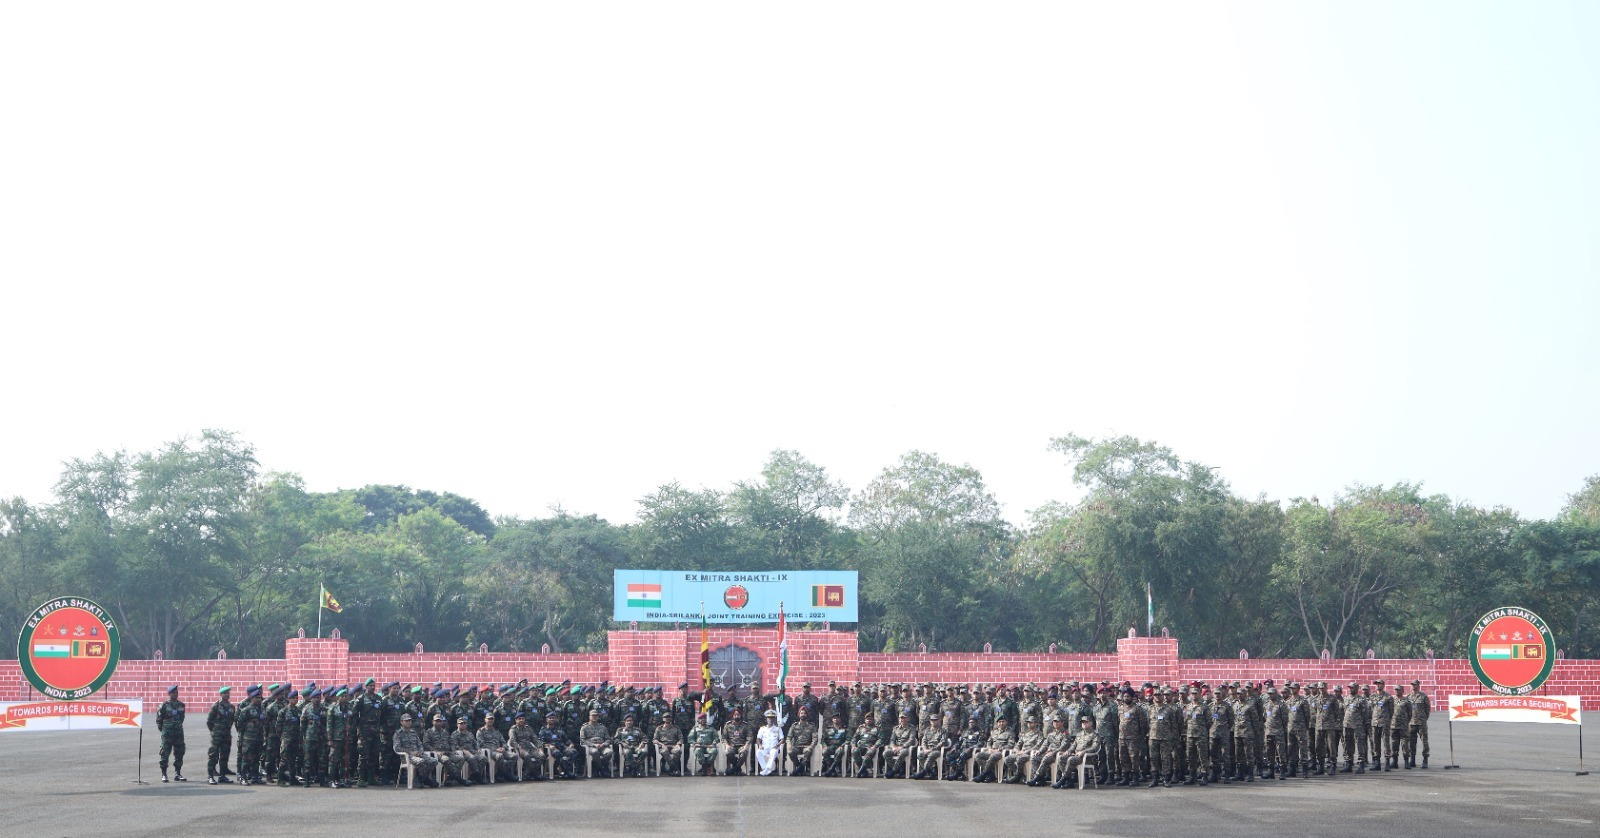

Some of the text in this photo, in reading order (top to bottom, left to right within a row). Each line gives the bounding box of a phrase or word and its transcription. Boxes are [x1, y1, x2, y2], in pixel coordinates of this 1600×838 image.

[700, 574, 731, 582] MITRA
[733, 574, 770, 582] SHAKTI
[28, 615, 41, 628] EX
[38, 599, 68, 617] MITRA
[69, 599, 104, 619] SHAKTI
[104, 620, 114, 631] IX
[1474, 623, 1484, 636] EX
[1482, 608, 1506, 625] MITRA
[1507, 608, 1537, 624] SHAKTI
[1539, 625, 1548, 635] IX
[44, 686, 68, 699] INDIA
[73, 687, 92, 698] 2023
[1491, 684, 1512, 695] INDIA
[1517, 684, 1533, 694] 2023
[9, 704, 127, 716] "TOWARDS PEACE & SECURITY"
[1464, 699, 1565, 710] "TOWARDS PEACE & SECURITY"
